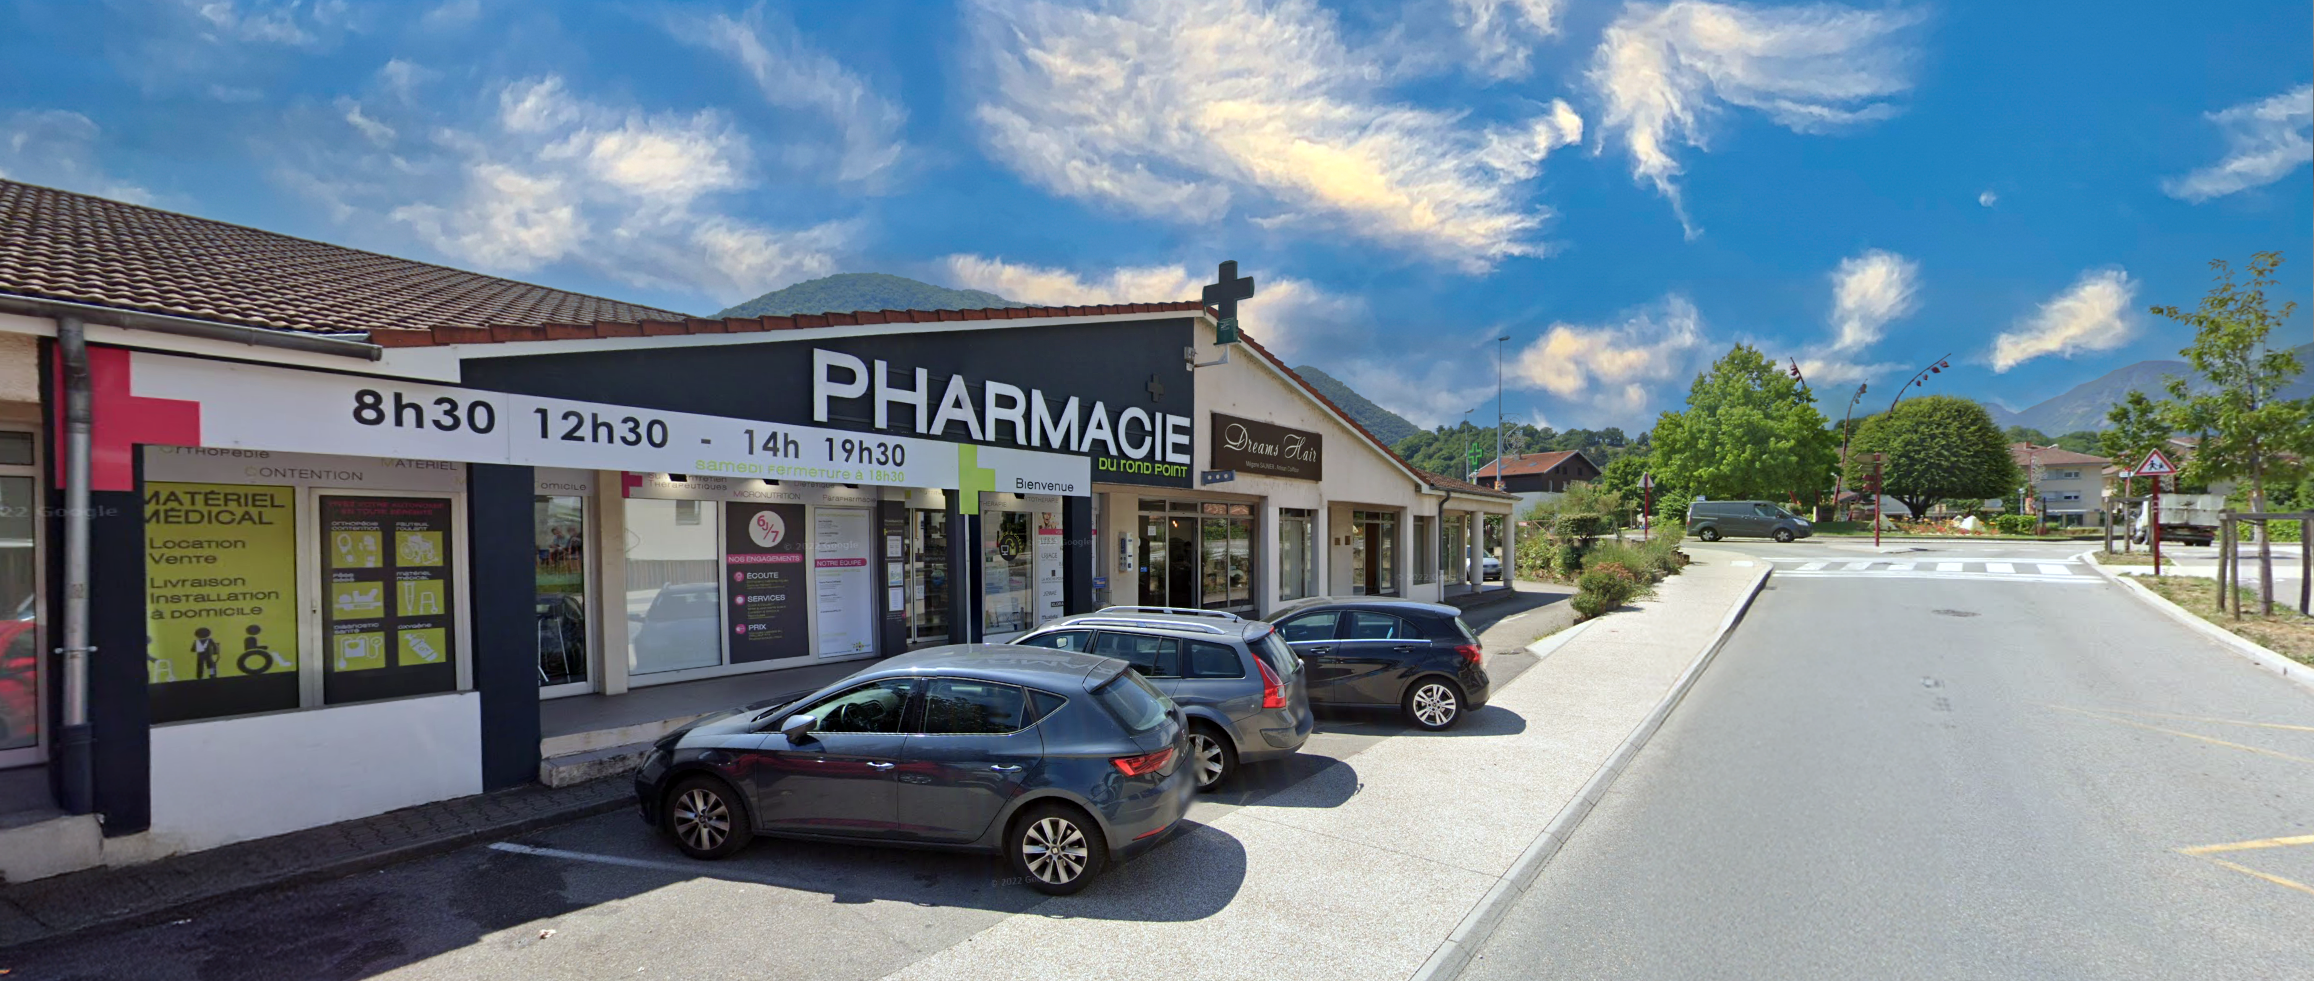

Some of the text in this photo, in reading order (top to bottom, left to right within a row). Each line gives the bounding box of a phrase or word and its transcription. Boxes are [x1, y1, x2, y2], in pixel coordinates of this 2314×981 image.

[813, 348, 1191, 464] PHARMACIE
[352, 389, 496, 434] 8h30
[533, 407, 669, 448] 12h30
[743, 429, 799, 459] 14h
[824, 437, 906, 467] 19h30
[1224, 423, 1317, 462] Dreams Hair
[245, 465, 363, 481] CONTENTION
[870, 470, 905, 482] 18h30
[1016, 477, 1074, 492] Bienvenue
[145, 490, 285, 508] MATÉRIEL
[733, 490, 801, 500] MICRONUTRITION
[145, 507, 274, 525] MÉDICAL
[149, 537, 246, 549] Location
[149, 553, 217, 565] Vente
[150, 577, 246, 589] Livraison
[150, 591, 279, 604] Installation
[748, 594, 786, 602] SERVICES
